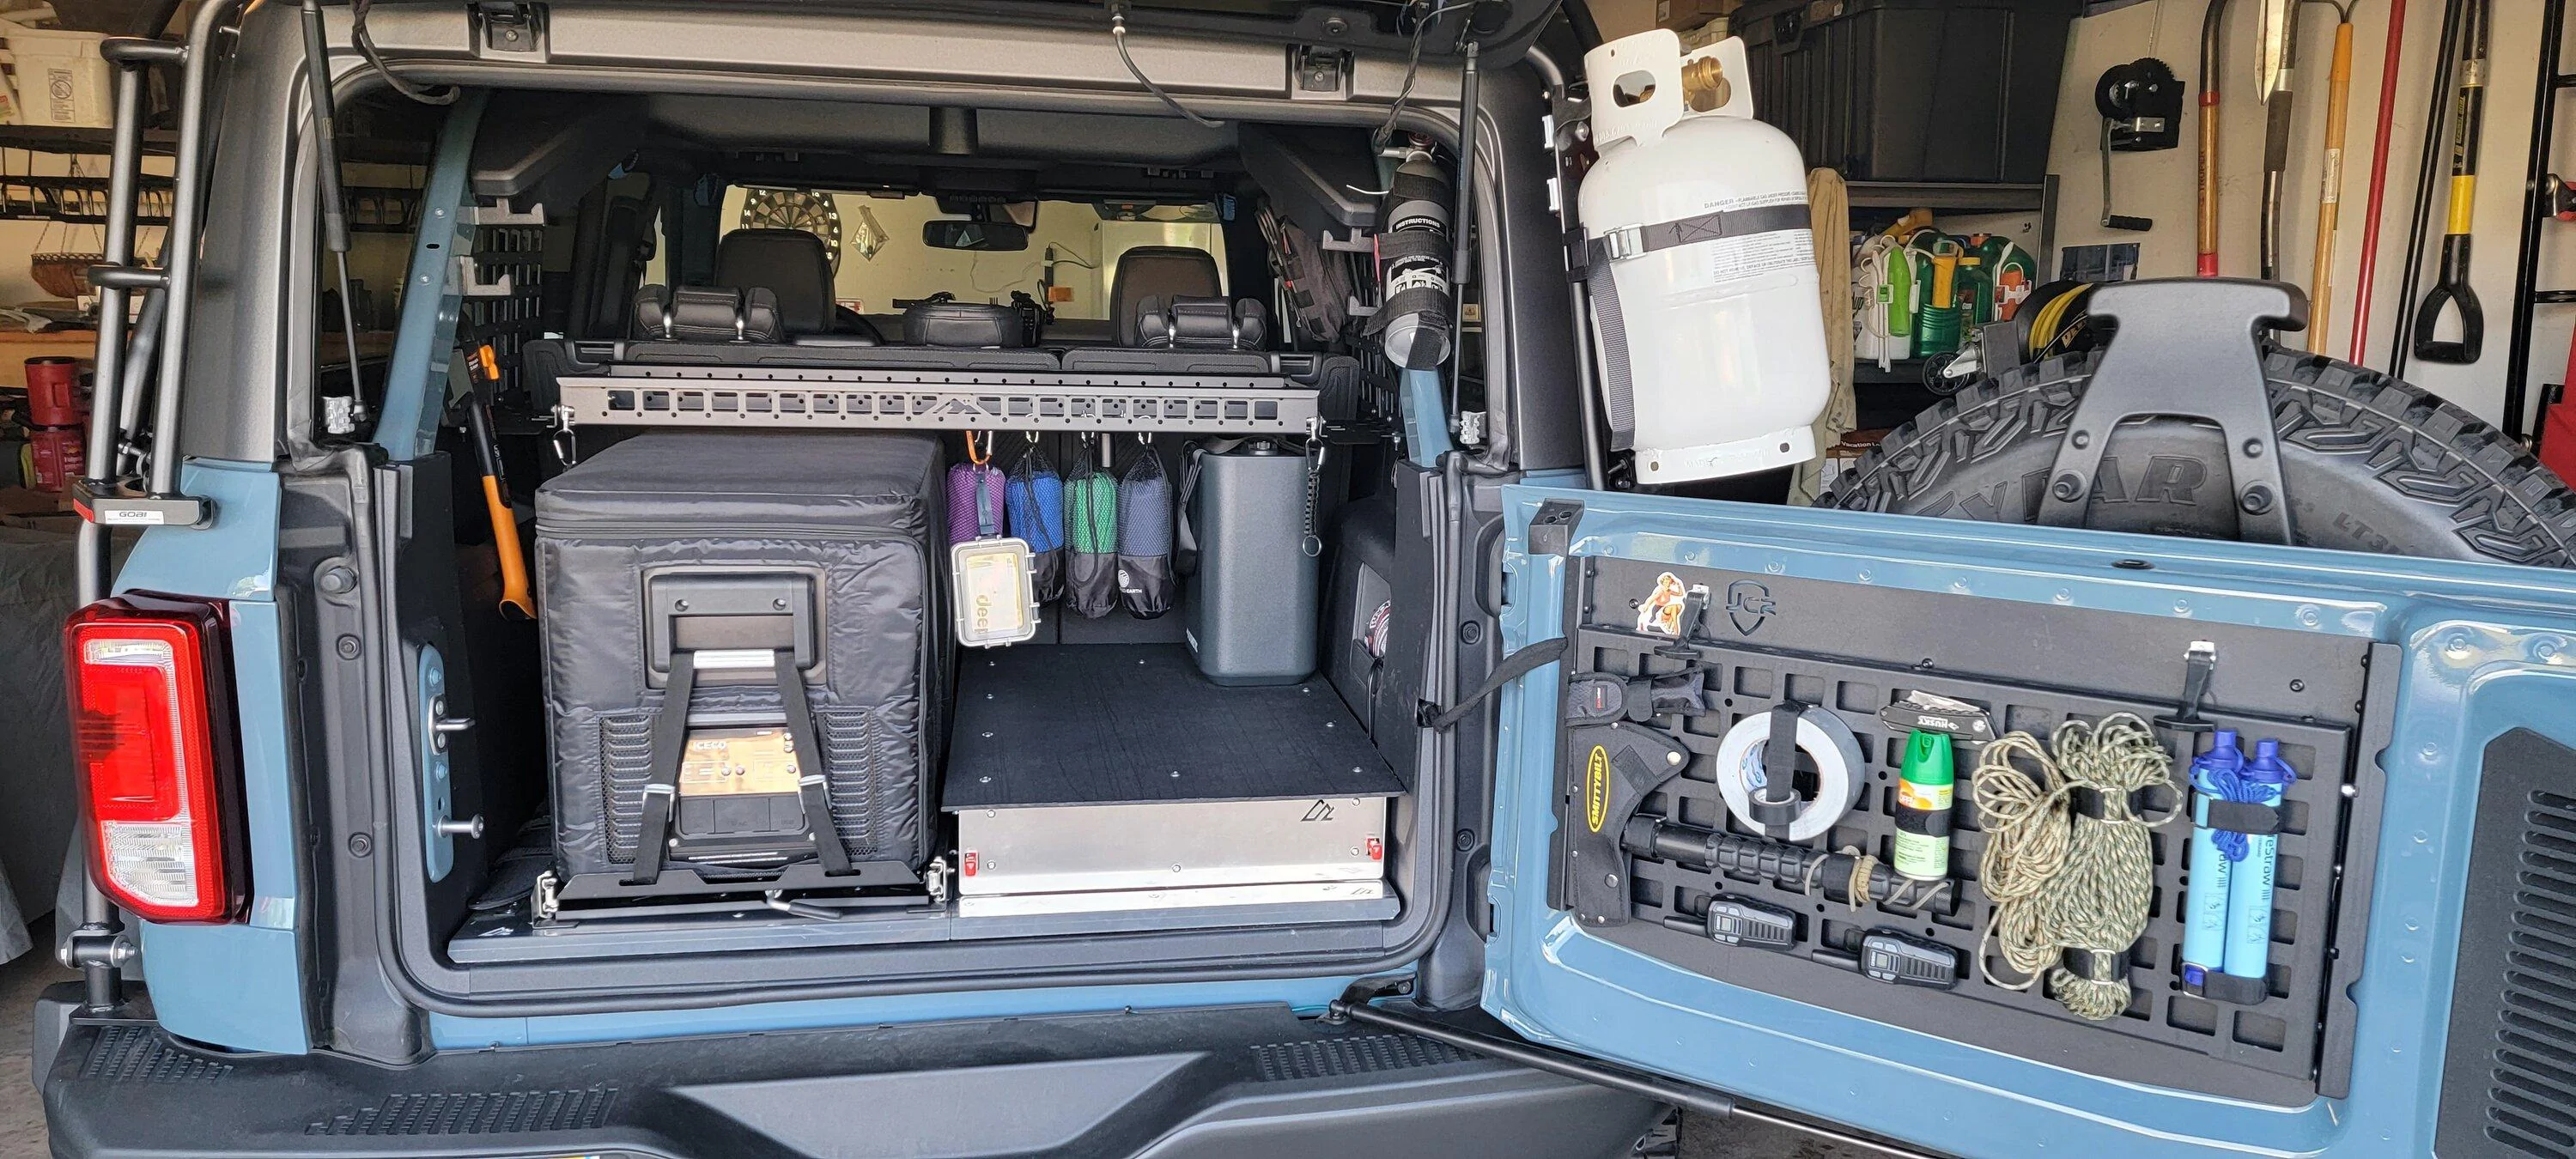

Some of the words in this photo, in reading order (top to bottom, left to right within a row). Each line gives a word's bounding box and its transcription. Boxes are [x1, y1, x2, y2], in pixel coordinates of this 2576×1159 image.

[1704, 198, 1734, 209] DANGER
[1395, 218, 1440, 229] INSTRUCTIONS
[1917, 714, 1949, 729] HUSKY
[1591, 752, 1604, 826] SMITTYBILT
